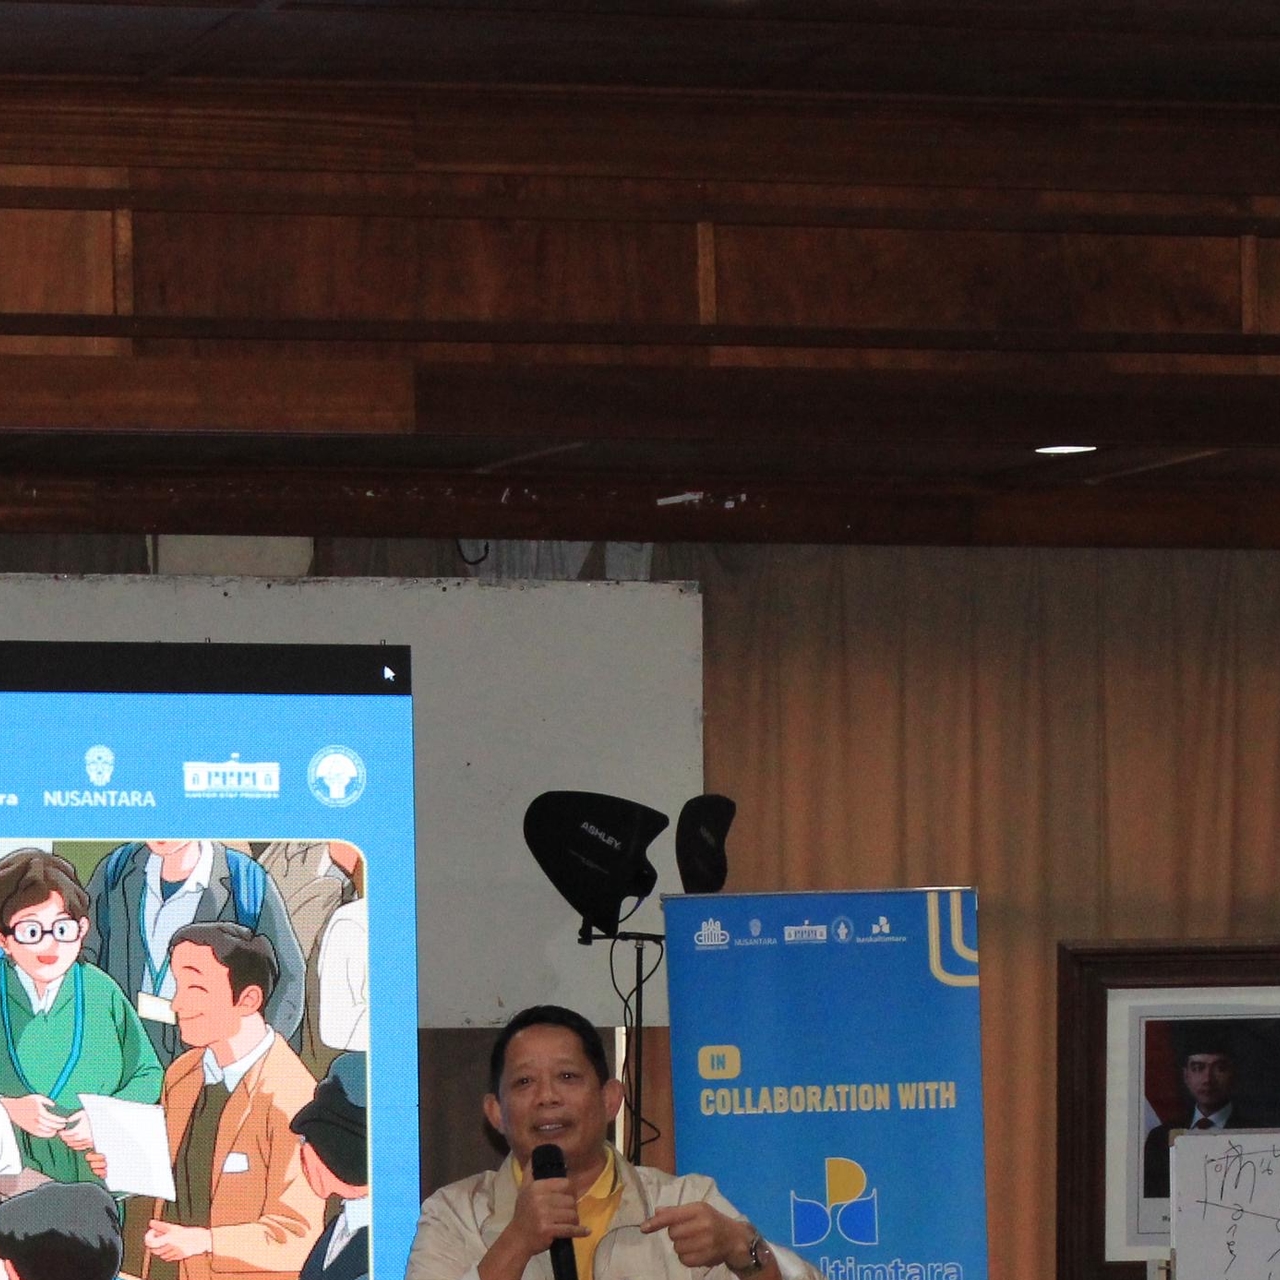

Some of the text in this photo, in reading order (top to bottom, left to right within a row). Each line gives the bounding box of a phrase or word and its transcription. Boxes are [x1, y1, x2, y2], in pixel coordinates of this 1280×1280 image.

[43, 790, 156, 807] NUSANTARA
[580, 821, 622, 849] ASHLEY
[710, 1053, 727, 1071] IN
[700, 1081, 956, 1116] COLLABORATION WITH
